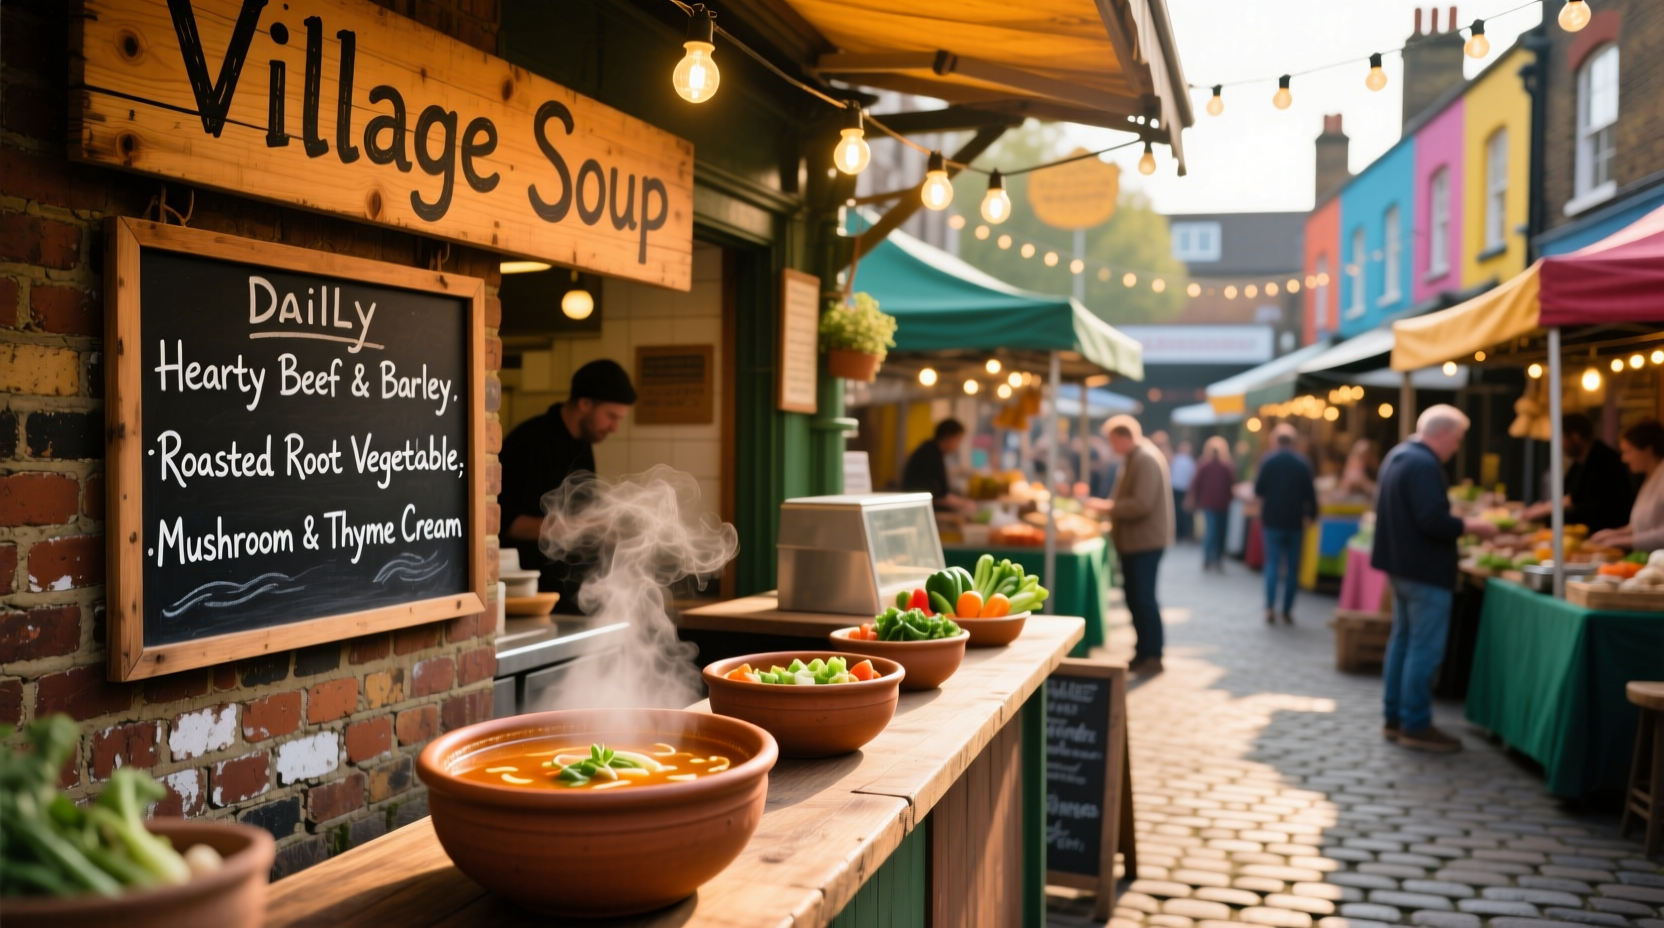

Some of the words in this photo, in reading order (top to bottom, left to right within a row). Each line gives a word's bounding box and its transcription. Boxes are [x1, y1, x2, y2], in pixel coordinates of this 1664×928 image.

[166, 0, 501, 222] Village
[527, 100, 670, 265] Soup
[154, 339, 266, 412] Hearty
[277, 352, 343, 398] Beef
[351, 362, 370, 398] &
[284, 432, 344, 481] Root
[302, 514, 320, 551] &
[323, 509, 396, 565] Thyme
[401, 503, 462, 543] Cream
